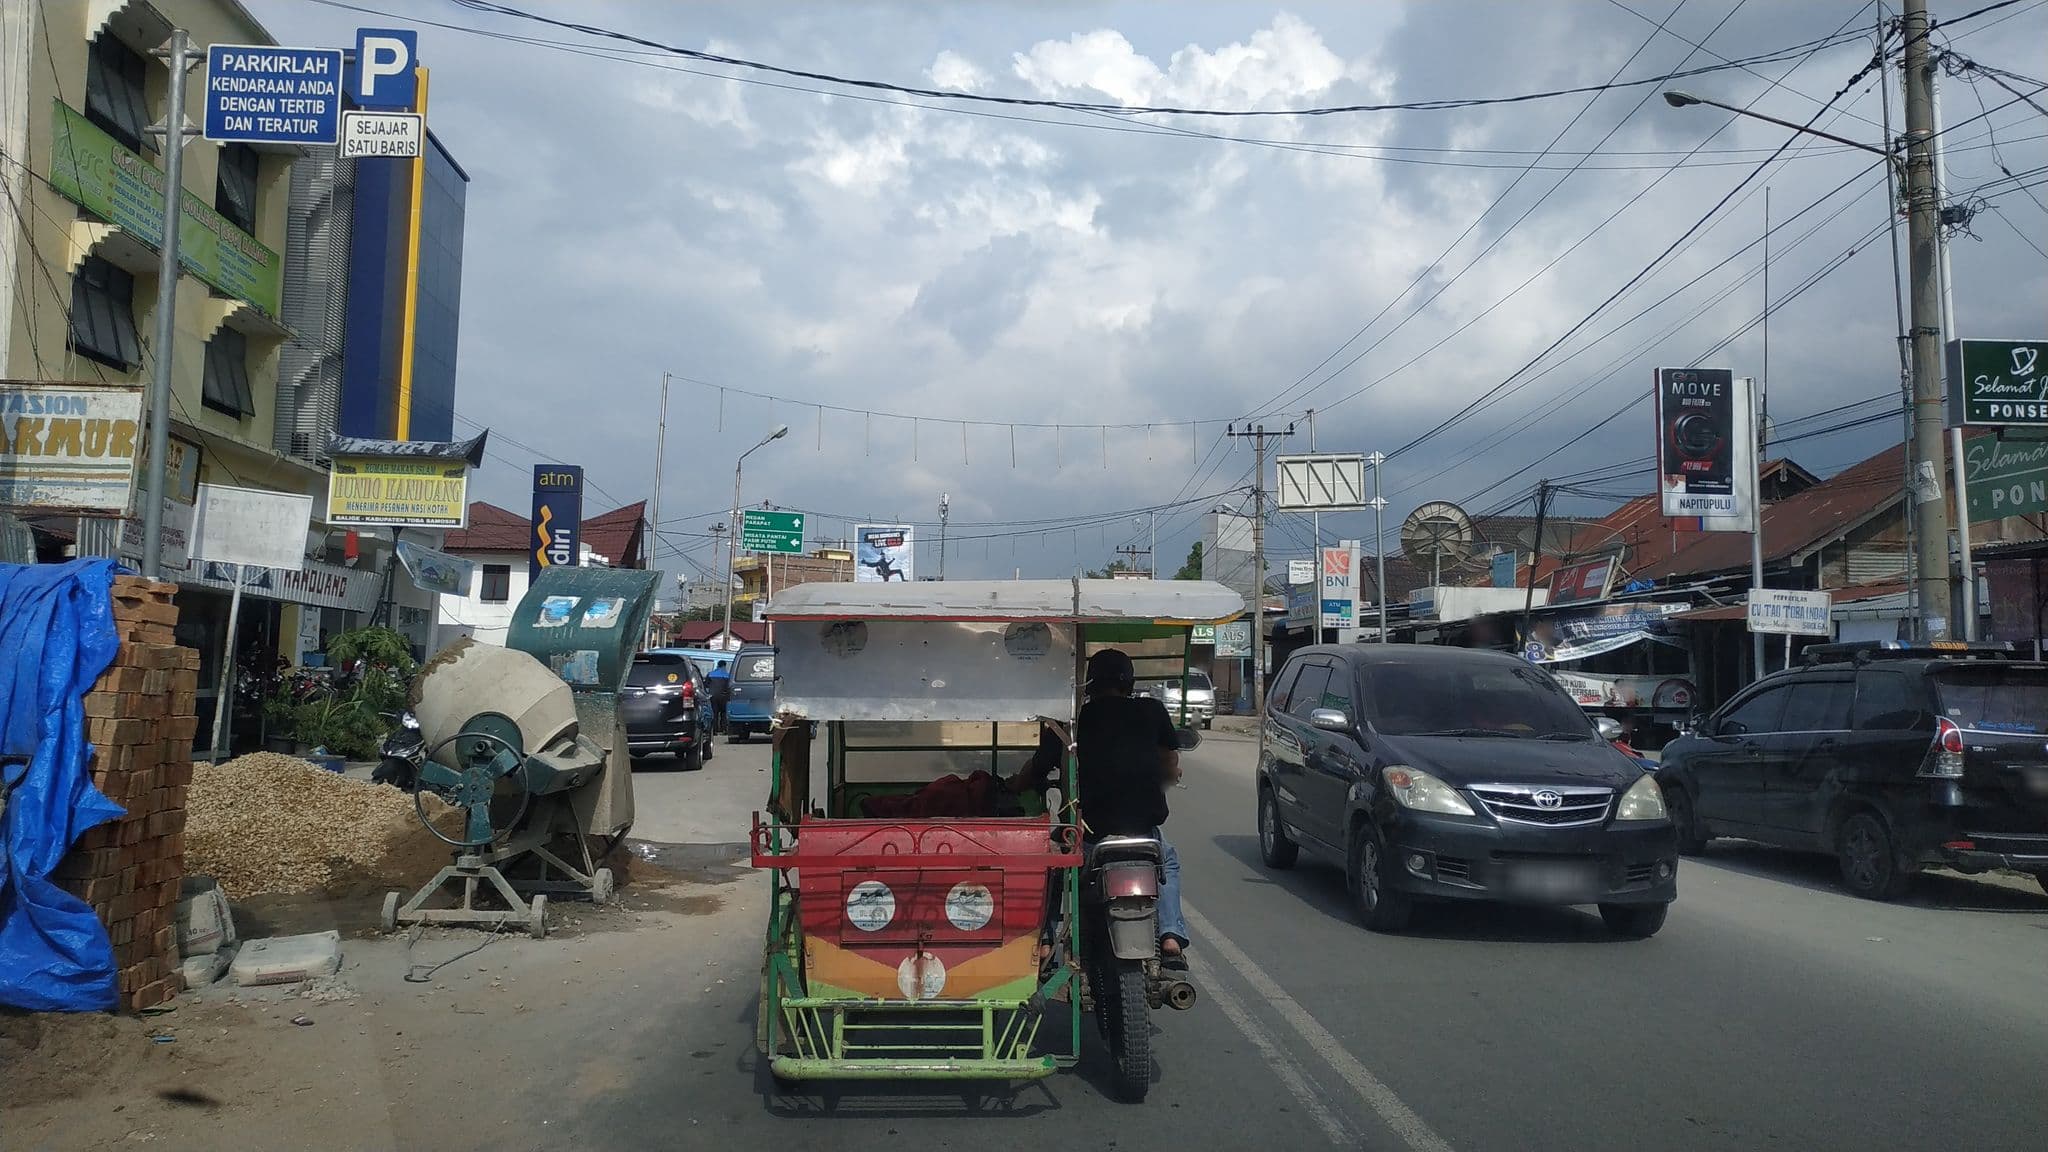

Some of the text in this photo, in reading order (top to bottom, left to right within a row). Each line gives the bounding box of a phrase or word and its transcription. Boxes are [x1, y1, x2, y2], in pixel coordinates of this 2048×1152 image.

[222, 54, 328, 74] PARKIRLAH
[361, 37, 408, 96] P
[212, 76, 335, 96] KENDARAAN ANDA
[220, 96, 325, 114] DENGAN TERTIB
[224, 115, 318, 134] DAN TERATUR
[356, 120, 408, 136] SEJAJAR
[348, 139, 415, 155] SATU BARIS
[1672, 382, 1721, 396] MOVE
[1974, 375, 2037, 395] Selamat
[539, 472, 574, 487] atm
[385, 478, 462, 502] KANDUANG
[1992, 481, 2046, 509] PON
[346, 501, 448, 514] MENERIMA PESANAN NASI KOTAK
[1680, 499, 1731, 510] NAPITUPULU
[1326, 576, 1349, 587] BNI
[1783, 605, 1805, 618] TOBA
[1806, 606, 1828, 619] INDAH
[1222, 631, 1245, 641] ALS
